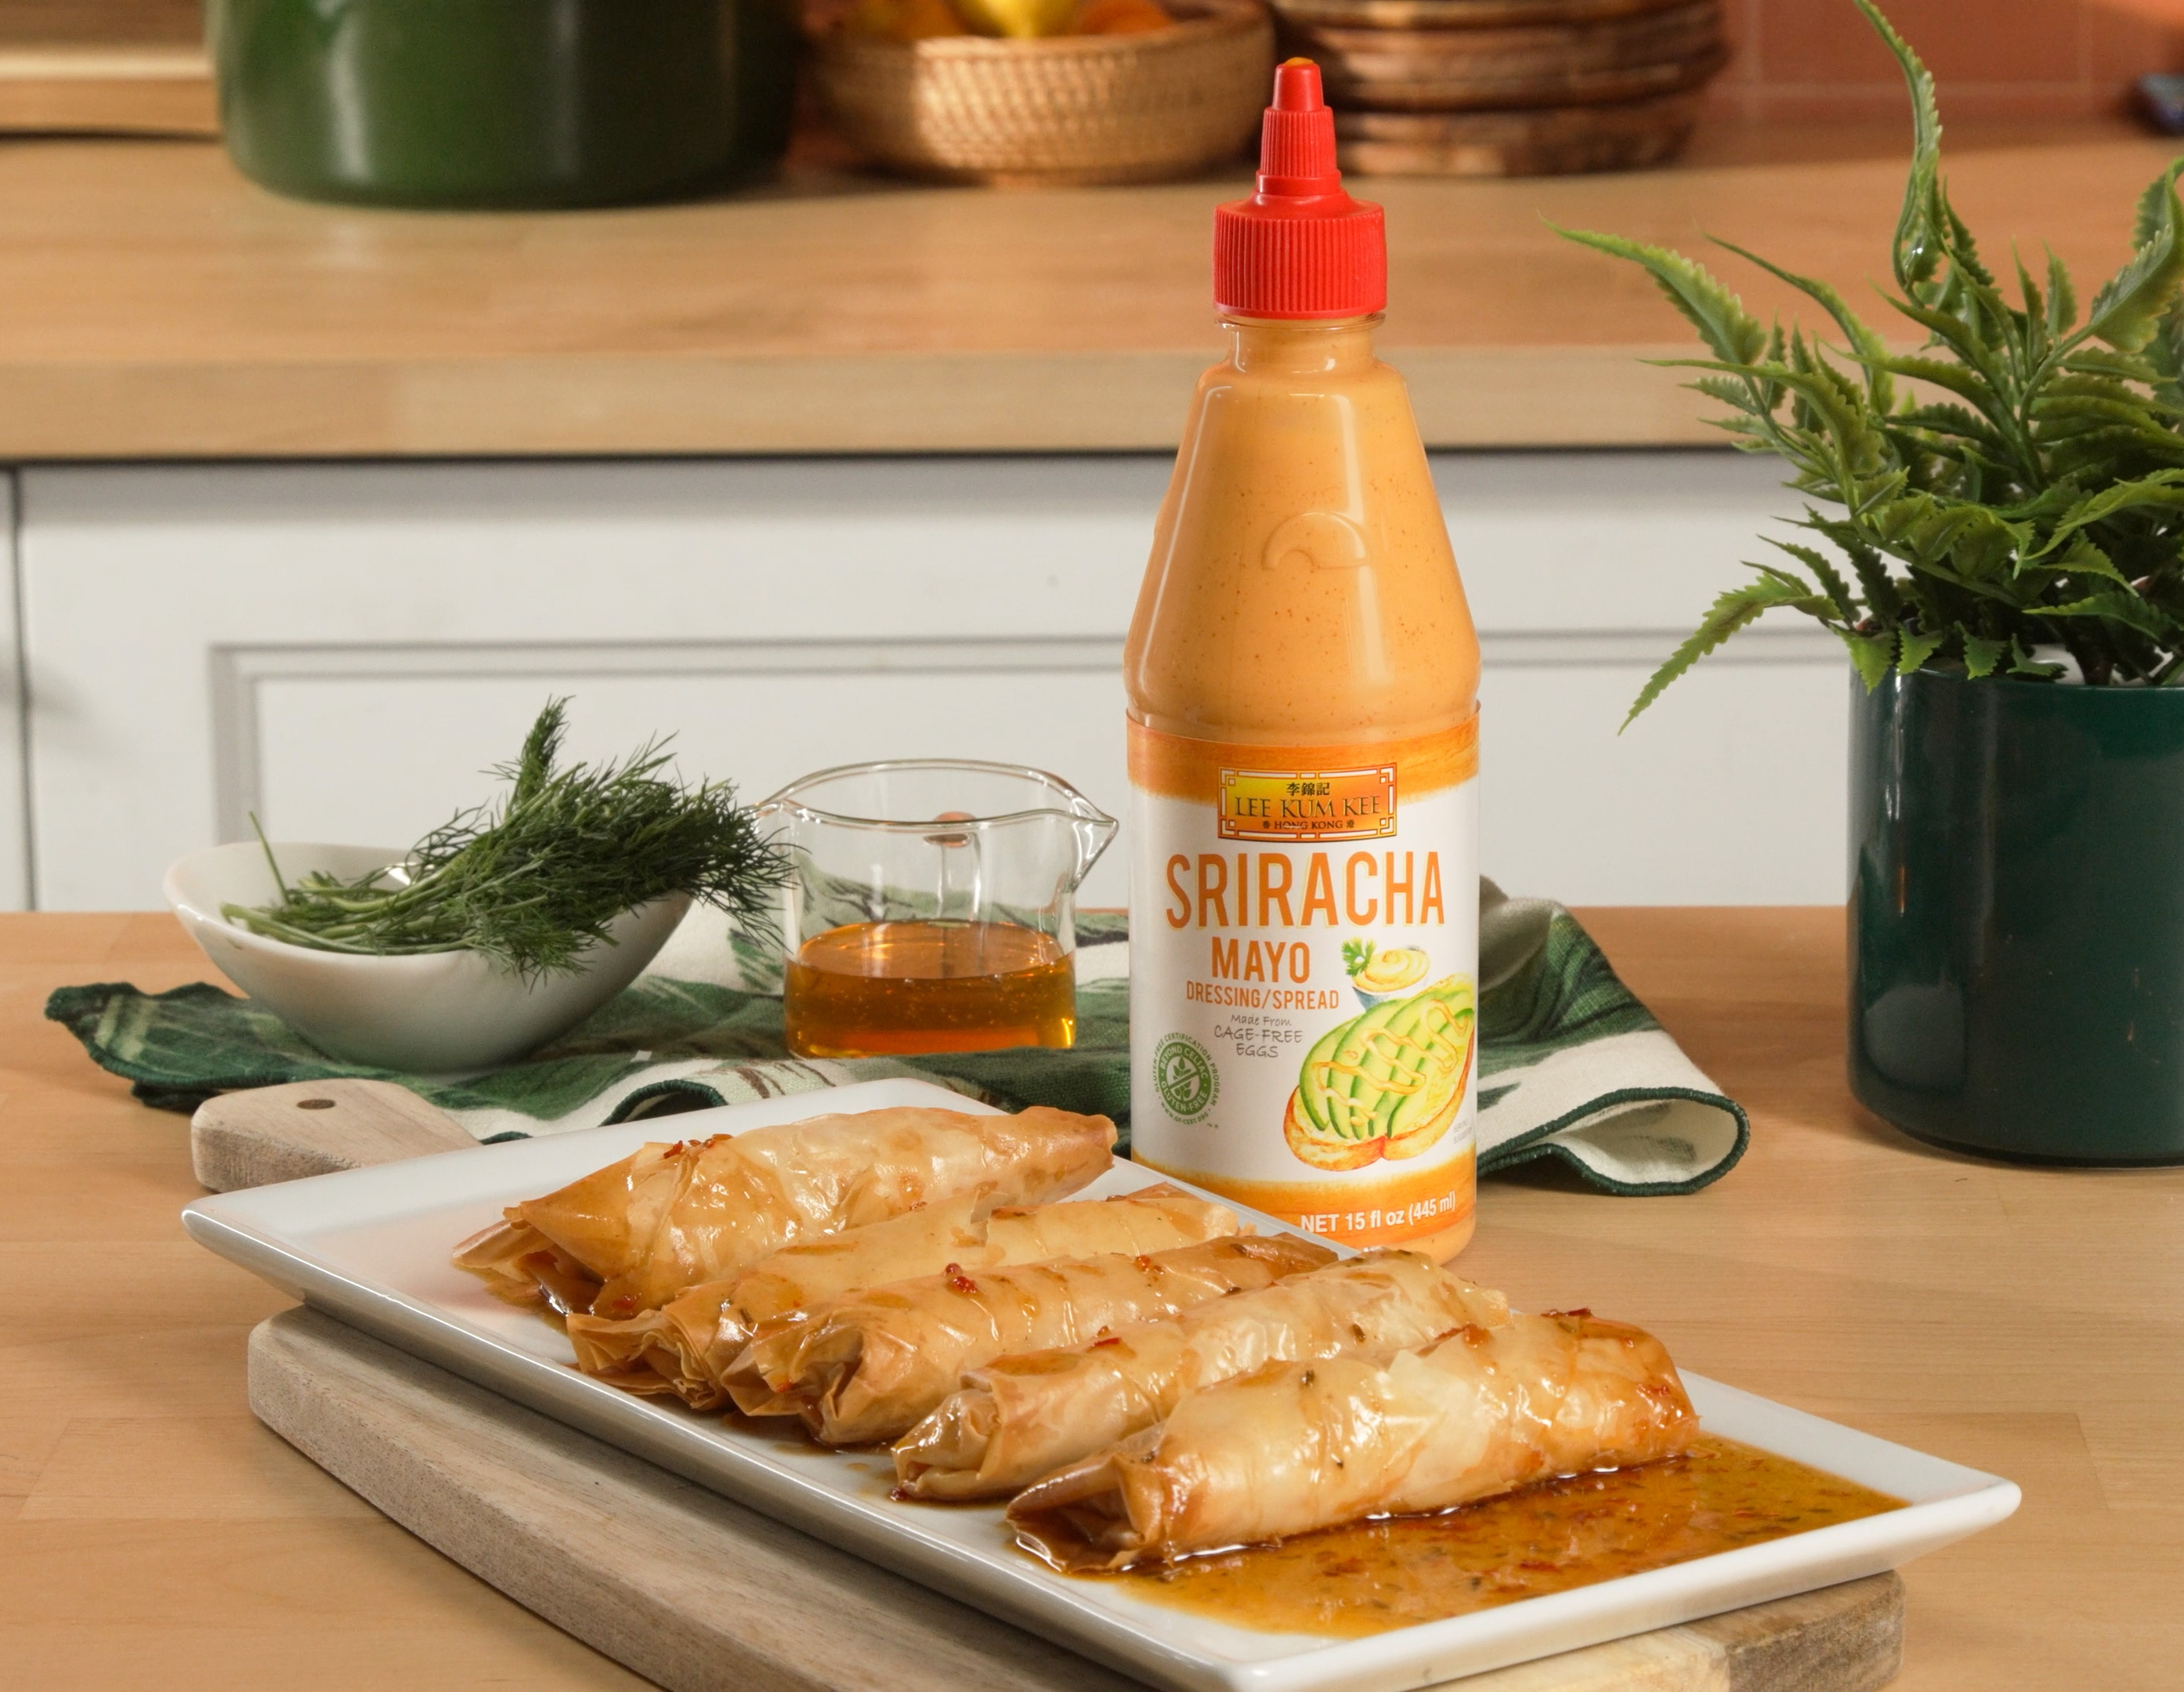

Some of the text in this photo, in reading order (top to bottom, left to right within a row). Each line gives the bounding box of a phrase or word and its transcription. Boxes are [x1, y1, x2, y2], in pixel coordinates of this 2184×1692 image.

[1286, 782, 1330, 797] 李錦記
[1235, 795, 1382, 819] LEE KUM KEE
[1274, 820, 1308, 830] HONG
[1311, 819, 1343, 830] KONG
[1165, 851, 1445, 931] SRIRACHA
[1210, 936, 1311, 984] MAYO
[1186, 980, 1340, 1010] DRESSING/SPREAD
[1213, 1025, 1304, 1043] CAGE-FREE
[1231, 1014, 1293, 1027] Made From
[1159, 1044, 1209, 1079] BEYOND CELIAC
[1236, 1043, 1279, 1058] EGGS
[1164, 1032, 1212, 1061] CERTIFICATION
[1209, 1062, 1220, 1107] PROGRAM
[1160, 1081, 1208, 1112] GLUTEN-FREE
[1300, 1190, 1456, 1233] NET 15 fl oz (445 ml)
